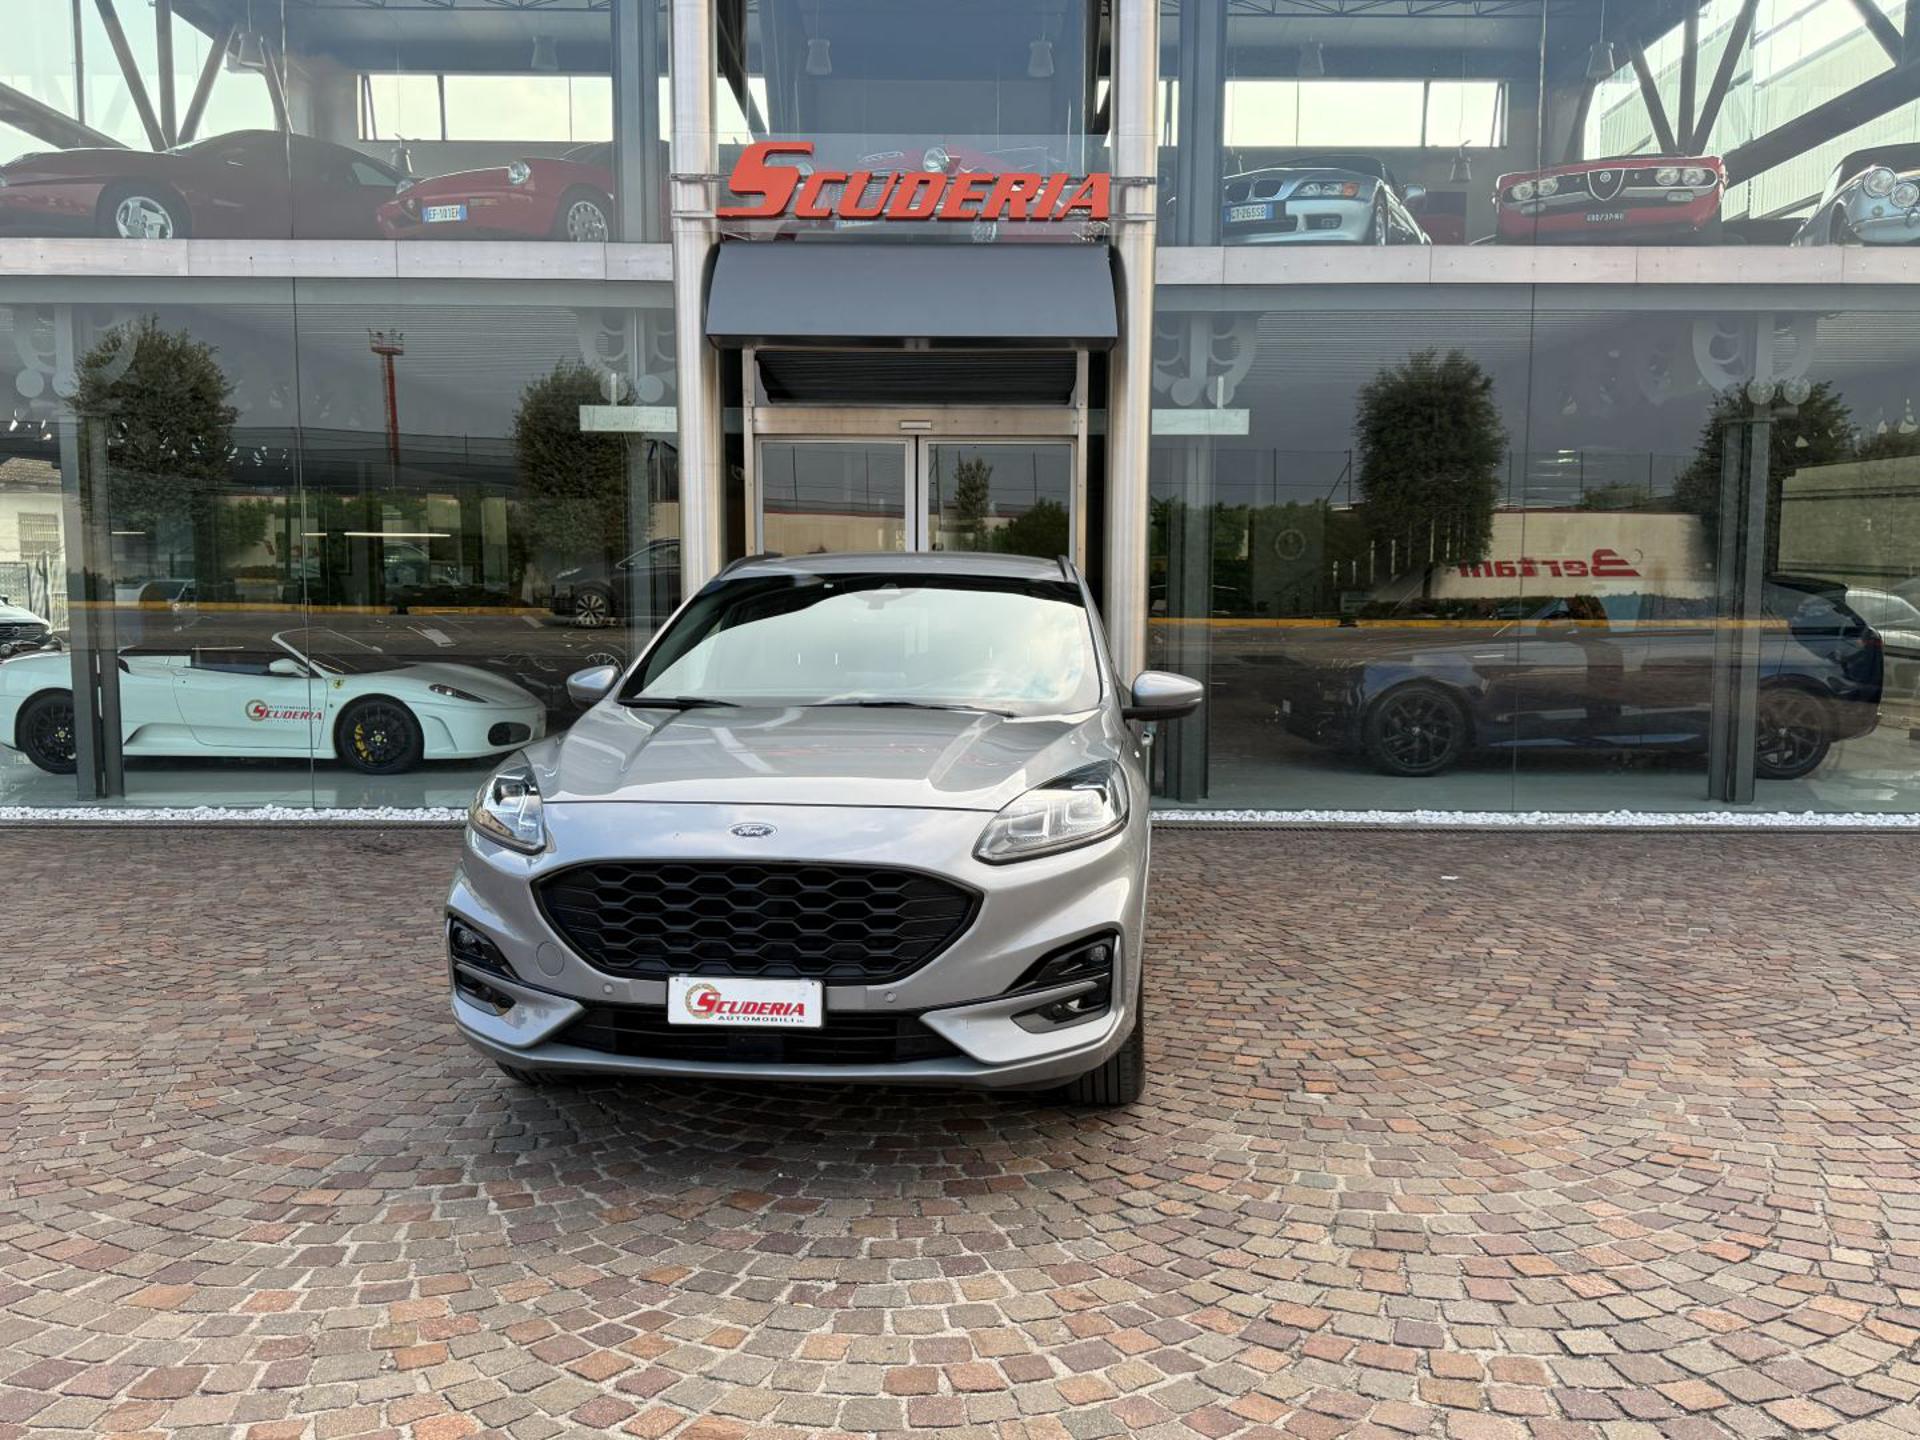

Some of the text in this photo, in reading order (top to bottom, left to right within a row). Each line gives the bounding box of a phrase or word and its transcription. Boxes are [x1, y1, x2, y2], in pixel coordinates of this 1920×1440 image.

[716, 141, 1111, 222] SCUDERIA
[253, 705, 322, 720] SCUDERIA
[735, 825, 771, 837] Ford
[693, 992, 805, 1016] SCUDERIA
[718, 1015, 794, 1023] AUTOMOBILI
